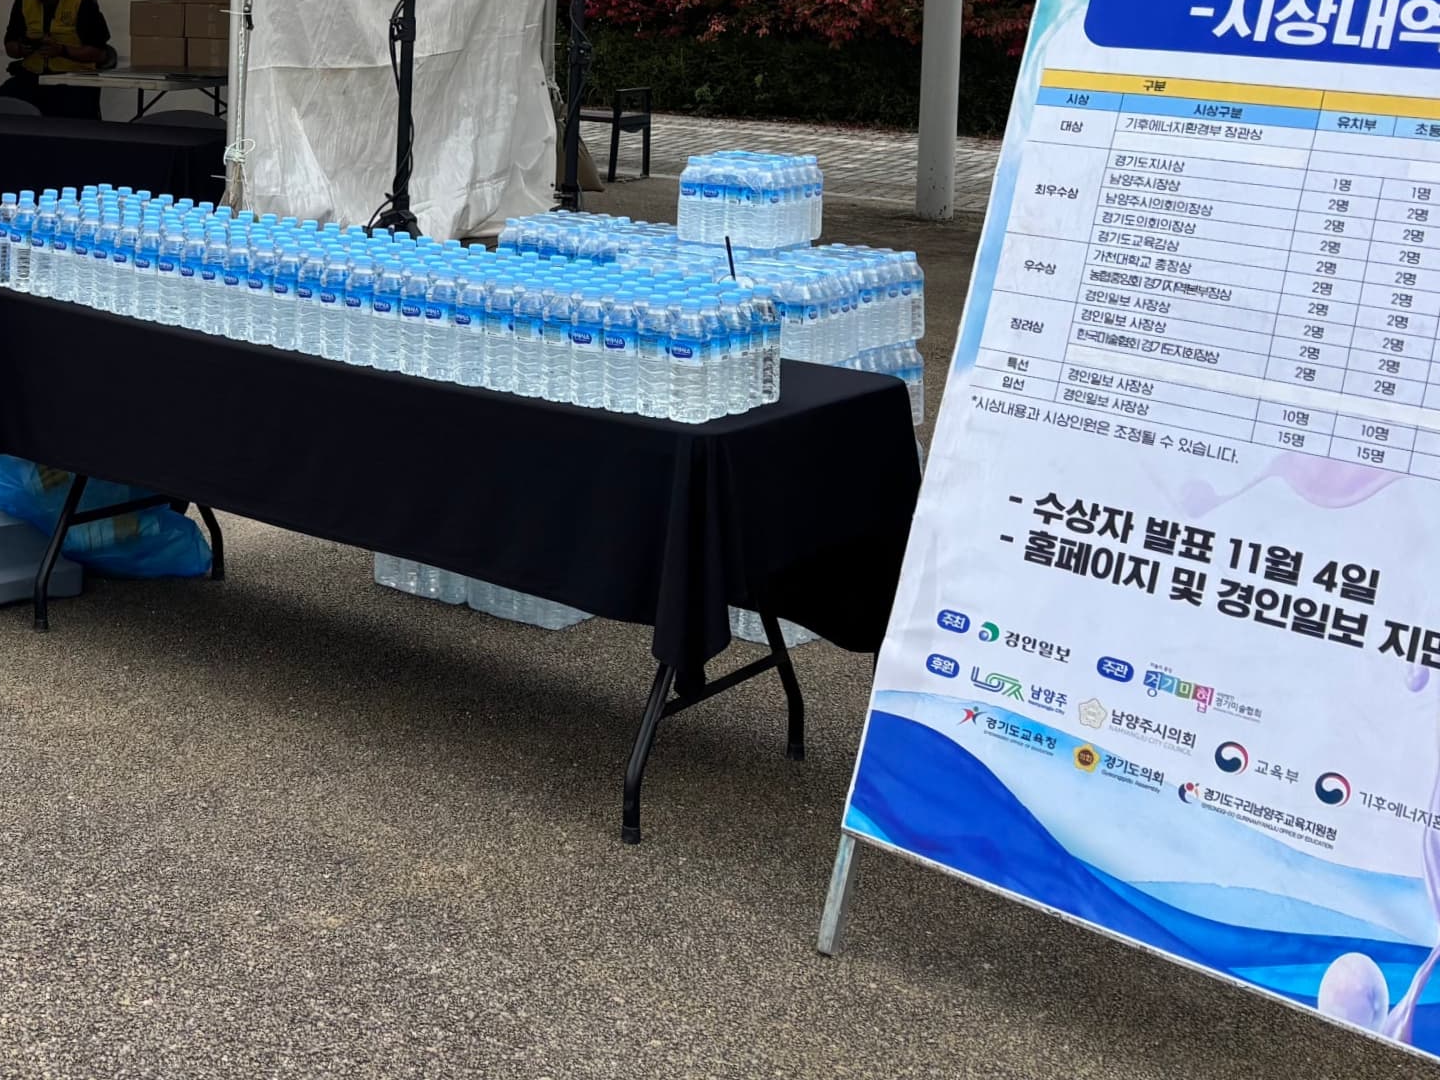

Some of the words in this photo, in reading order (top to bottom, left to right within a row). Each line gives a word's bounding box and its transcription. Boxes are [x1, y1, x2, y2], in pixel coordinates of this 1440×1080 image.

[1143, 80, 1167, 92] 구분
[1060, 120, 1084, 133] 대상
[1125, 117, 1223, 137] 기후에너지환경부
[1224, 125, 1263, 141] 장관상
[1066, 93, 1090, 106] 시상
[1193, 104, 1244, 119] 시상구분
[1337, 116, 1377, 131] 유치부
[1034, 183, 1079, 200] 최우수상
[1110, 173, 1181, 192] 남양주시장상
[1328, 198, 1349, 213] 2명
[1407, 208, 1429, 222] 2명
[1333, 178, 1352, 192] 1명
[1412, 186, 1432, 201] 1명
[1102, 211, 1197, 235] 경기도의회의장상
[1320, 240, 1341, 254] 2명
[1399, 250, 1421, 265] 2명
[1105, 192, 1214, 217] 남양주시의회의장상
[1323, 219, 1345, 233] 2명
[1403, 229, 1425, 243] 2명
[1023, 259, 1057, 276] 우수상
[1093, 249, 1152, 269] 가천대학교
[1155, 258, 1192, 275] 총장상
[1311, 281, 1333, 296] 2명
[1391, 293, 1413, 308] 2명
[1097, 230, 1180, 252] 경기도교육감상
[1315, 260, 1337, 275] 2명
[1394, 271, 1417, 286] 2명
[1085, 289, 1131, 307] 경인일보
[1133, 297, 1171, 314] 사장상
[1303, 324, 1325, 339] 2명
[1382, 337, 1405, 353] 2명
[1089, 269, 1143, 288] 농협중앙회
[1307, 302, 1329, 317] 2명
[1387, 314, 1409, 330] 2명
[1010, 317, 1044, 334] 장려상
[1081, 308, 1127, 327] 경인일보
[1130, 316, 1167, 334] 사장상
[1299, 346, 1320, 360] 2명
[1378, 359, 1400, 374] 2명
[1076, 328, 1140, 350] 한국미술협회
[1141, 339, 1220, 364] 경기도지회장상
[1295, 367, 1316, 382] 2명
[1373, 380, 1396, 396] 2명
[1002, 376, 1025, 391] 입선
[1063, 388, 1109, 408] 경인일보
[1112, 398, 1149, 417] 사장상
[1278, 431, 1305, 448] 15명
[1357, 446, 1385, 464] 15명
[1007, 356, 1030, 372] 특선
[1067, 368, 1114, 388] 경인일보
[1116, 378, 1154, 396] 사장상
[1282, 409, 1310, 426] 10명
[1361, 425, 1390, 442] 10명
[1043, 410, 1111, 437] 시상인원은
[1114, 424, 1156, 446] 조정될
[1159, 434, 1175, 449] 수
[1178, 437, 1239, 464] 있습니다.
[1033, 491, 1134, 544] 수상자
[1143, 517, 1216, 564] 발표
[1228, 538, 1304, 587] 11월
[1313, 560, 1380, 606] 4일
[1024, 529, 1160, 594] 홈페이지
[1169, 567, 1207, 607] 및
[1216, 578, 1369, 649] 경인일보
[1004, 630, 1071, 664] 경인일보
[1102, 659, 1130, 677] 주관
[1030, 685, 1068, 708] 남양주
[986, 716, 1057, 750] 경기도교육청
[1111, 709, 1196, 749] 남양주시의회
[1104, 754, 1164, 786] 경기도의회
[1255, 760, 1299, 785] 교육부
[1204, 788, 1337, 841] 경기도구리남양주교육지원청
